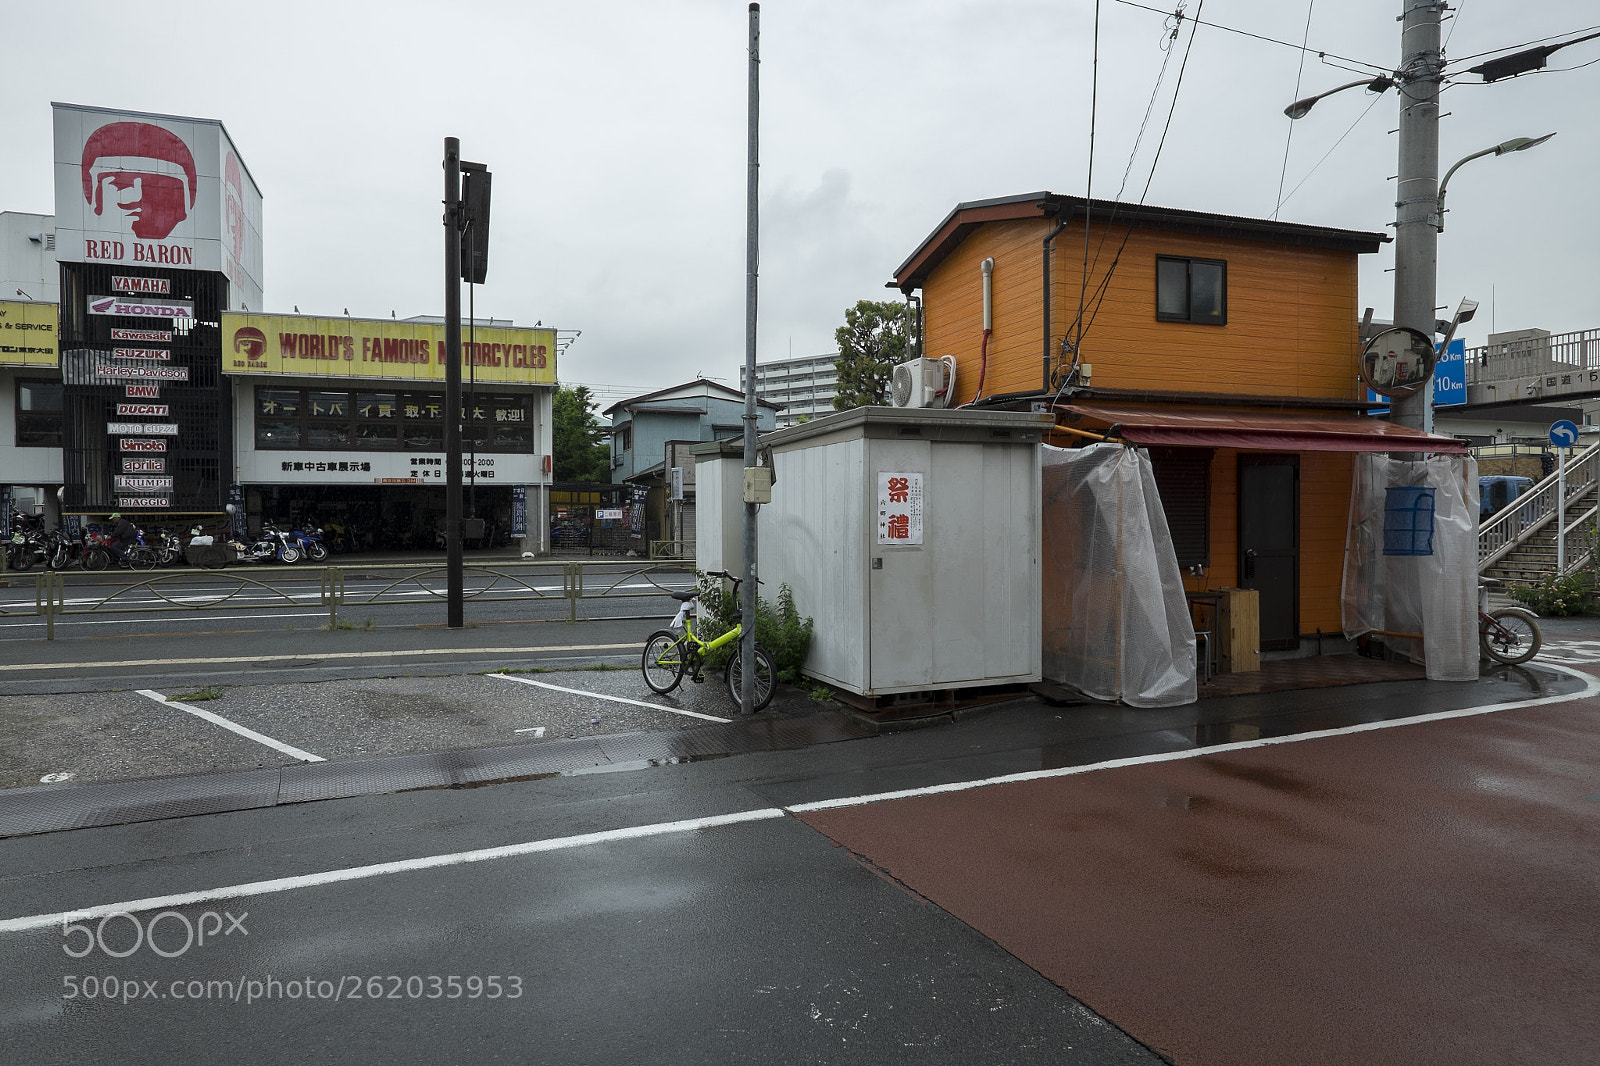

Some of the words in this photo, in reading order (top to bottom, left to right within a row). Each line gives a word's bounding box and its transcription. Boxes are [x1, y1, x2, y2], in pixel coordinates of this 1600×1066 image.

[86, 239, 124, 261] RED
[133, 242, 193, 265] BARON
[113, 276, 169, 293] YAMAHA
[114, 304, 190, 317] HONDA
[15, 323, 53, 331] SERVICE
[112, 330, 172, 342] Kawasaki
[0, 346, 54, 354] ロン東京大田
[115, 349, 170, 359] SUZUKI
[279, 333, 354, 361] WORLD'S
[362, 337, 430, 364] FAMOUS
[438, 341, 547, 369] MTORCYCLES
[97, 365, 187, 380] Harley-Davidson
[126, 385, 158, 397] BMW
[118, 405, 167, 415] DUCATI
[109, 423, 143, 434] MOTO
[145, 424, 178, 434] GUZZI
[121, 439, 165, 451] bimota
[123, 459, 163, 472] aprilia
[281, 461, 371, 472] 新車中古車展示場
[116, 476, 172, 487] TRIUMPH
[120, 498, 169, 507] PIAGGIO
